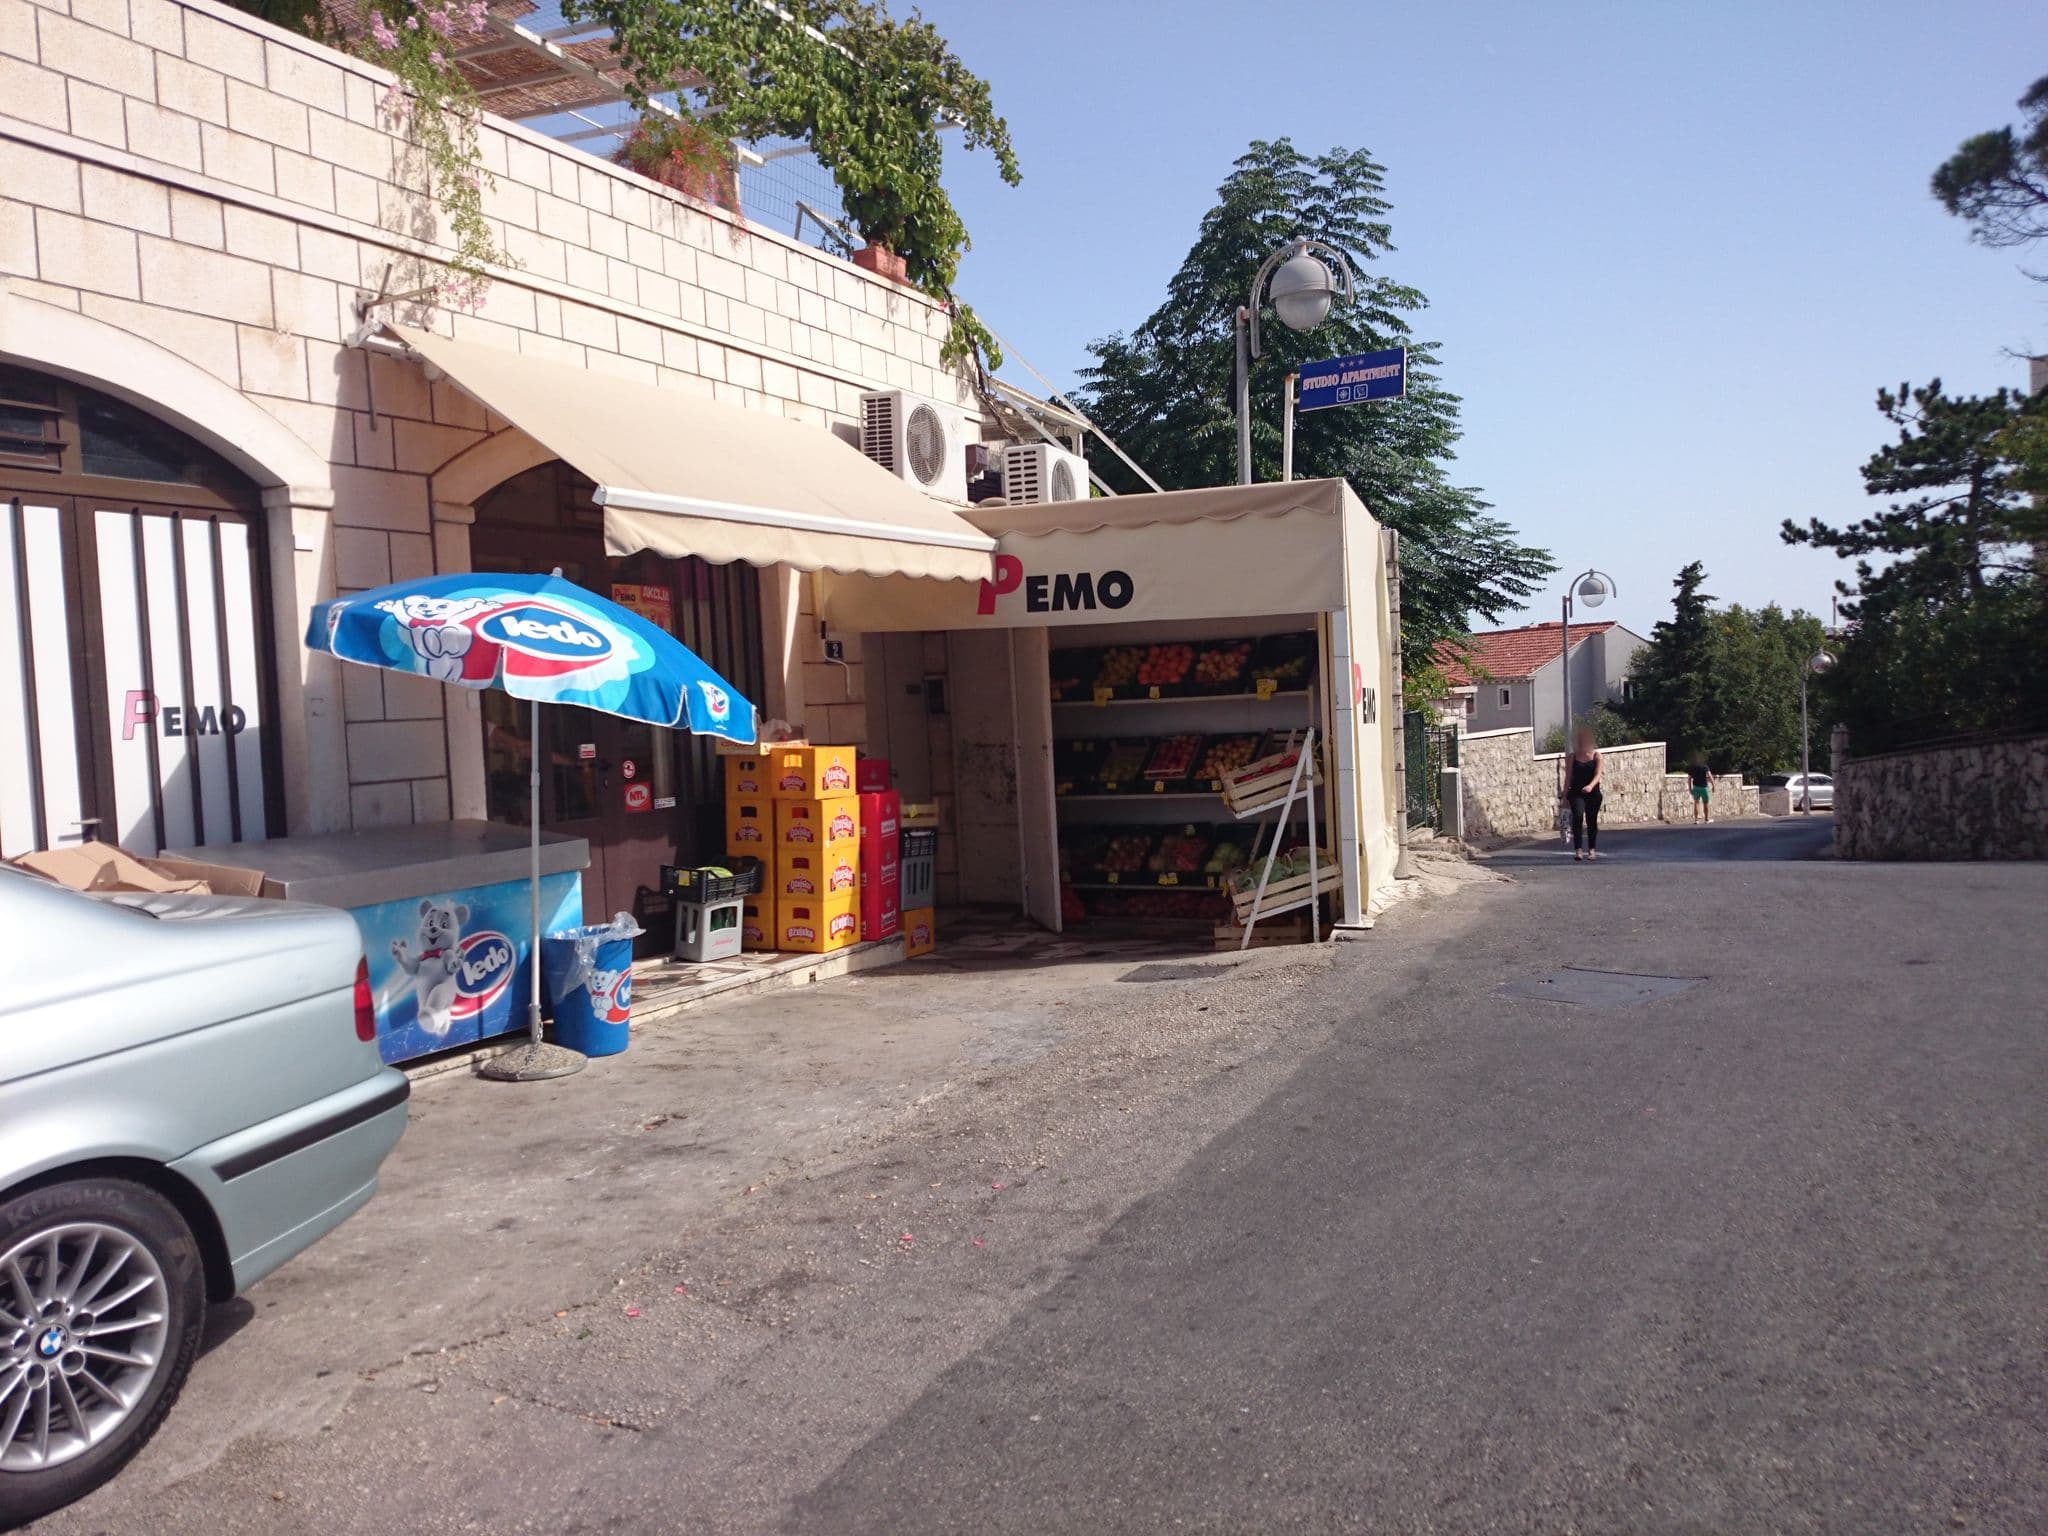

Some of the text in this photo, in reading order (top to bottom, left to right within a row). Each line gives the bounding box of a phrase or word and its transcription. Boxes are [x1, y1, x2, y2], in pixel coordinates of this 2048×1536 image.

[1302, 363, 1401, 391] STUDIO APARTMENT
[976, 554, 1135, 616] PEMO
[121, 689, 247, 741] PEMO
